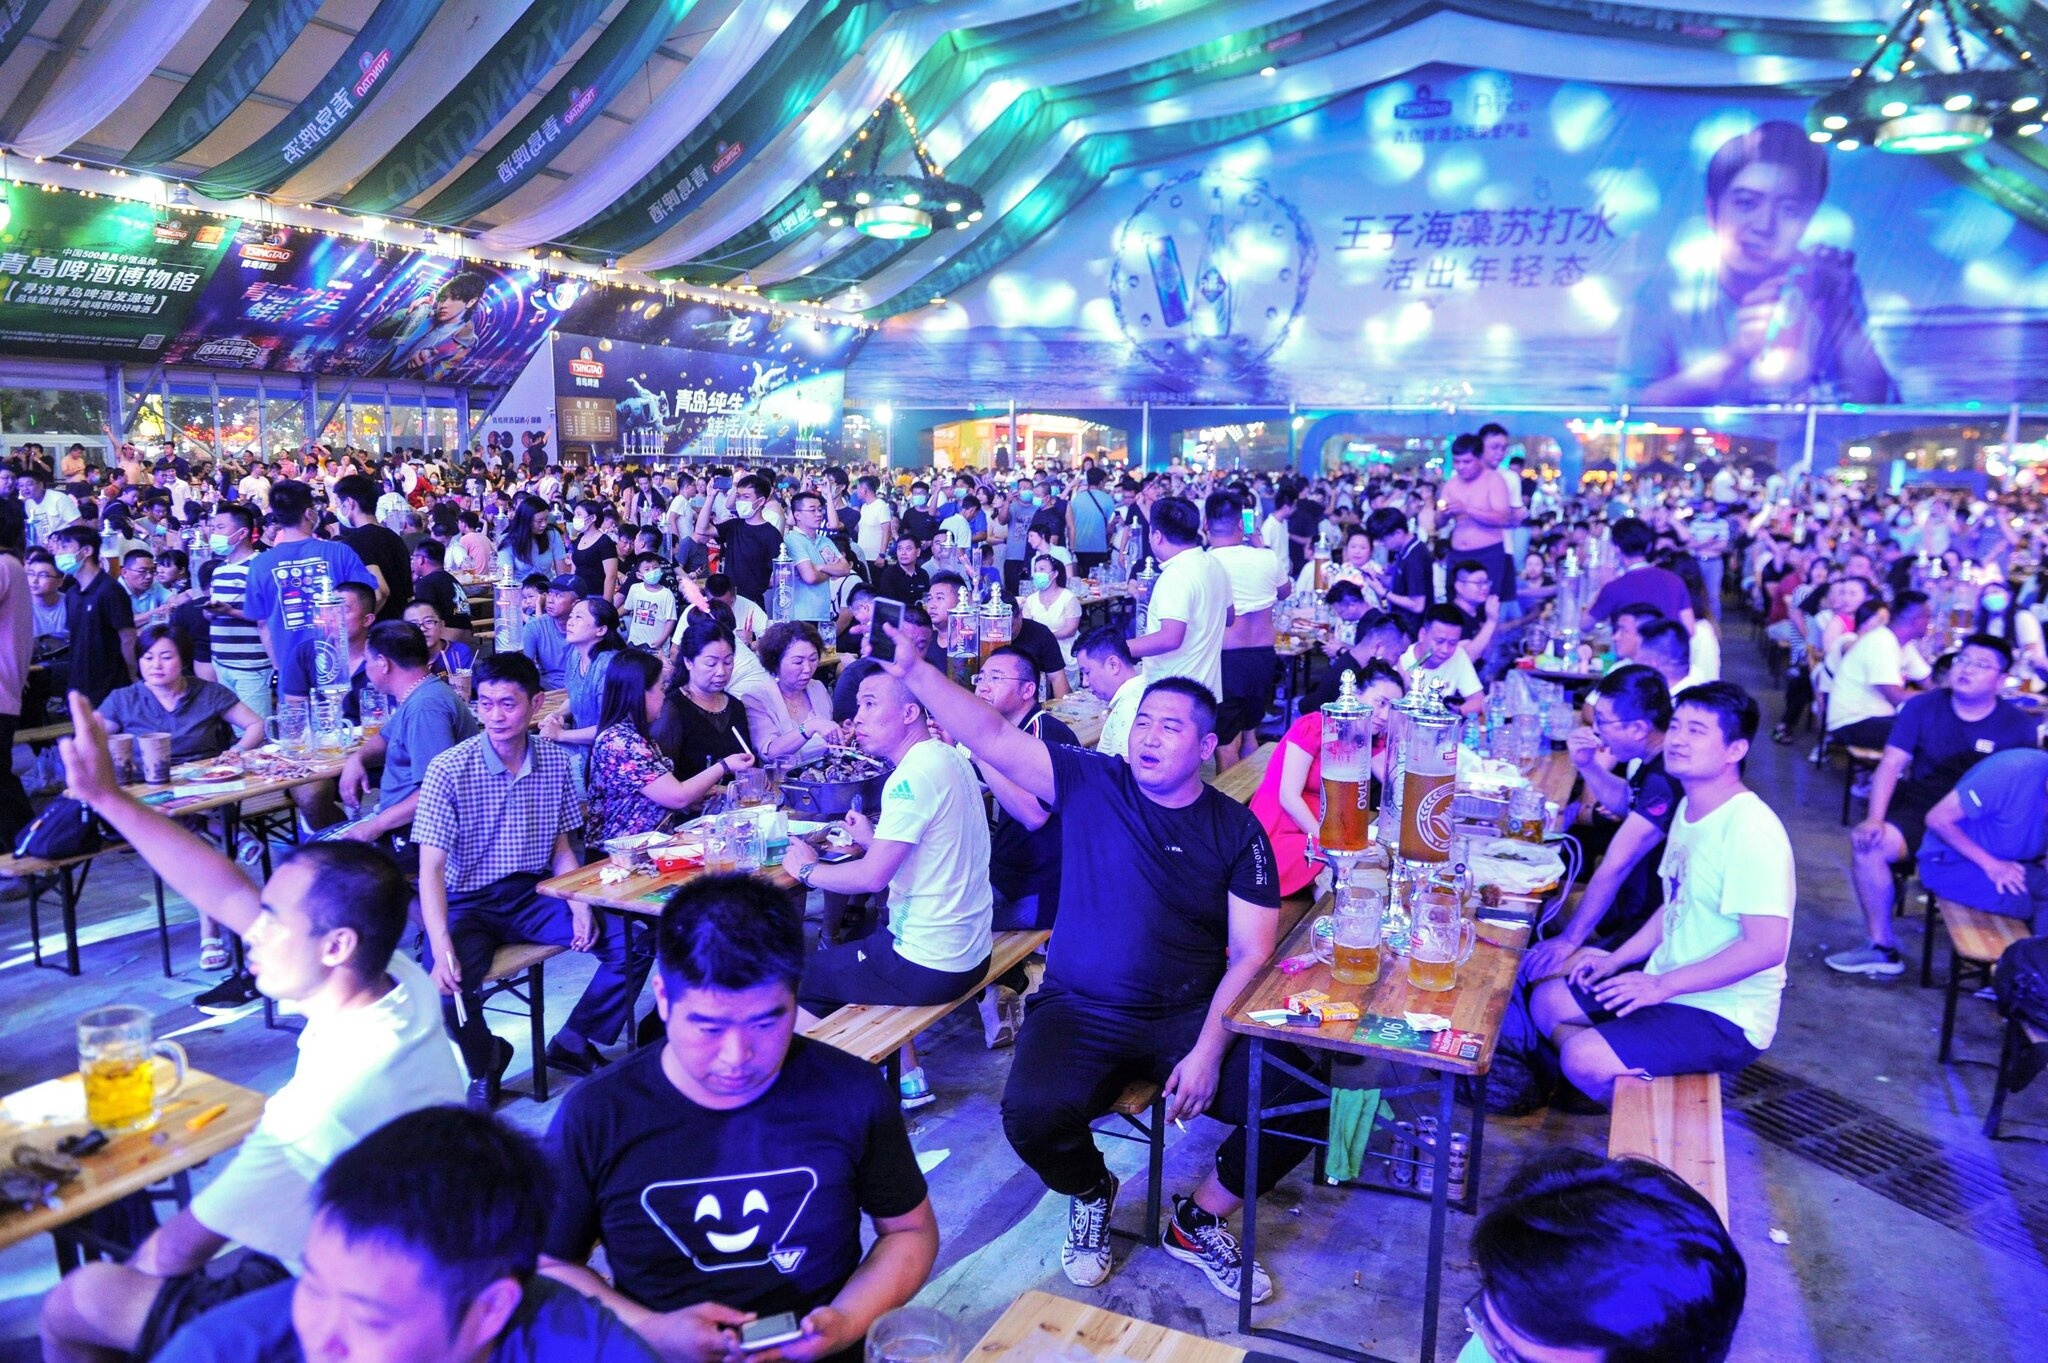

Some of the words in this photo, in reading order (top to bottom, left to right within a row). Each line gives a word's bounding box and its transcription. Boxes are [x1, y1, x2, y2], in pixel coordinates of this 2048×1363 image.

[1335, 204, 1618, 251] 王子海藻苏打水
[244, 246, 291, 262] TSINGTAO
[0, 252, 200, 293] 青島啤酒博物館
[1382, 252, 1590, 292] 活出年轻态
[53, 308, 80, 316] SINCE
[83, 310, 109, 318] 1903
[571, 362, 603, 376] TSINGTAO
[675, 387, 746, 418] 青岛纯生
[706, 415, 769, 440] 鲜活人生
[1252, 843, 1264, 885] RHAPSODY
